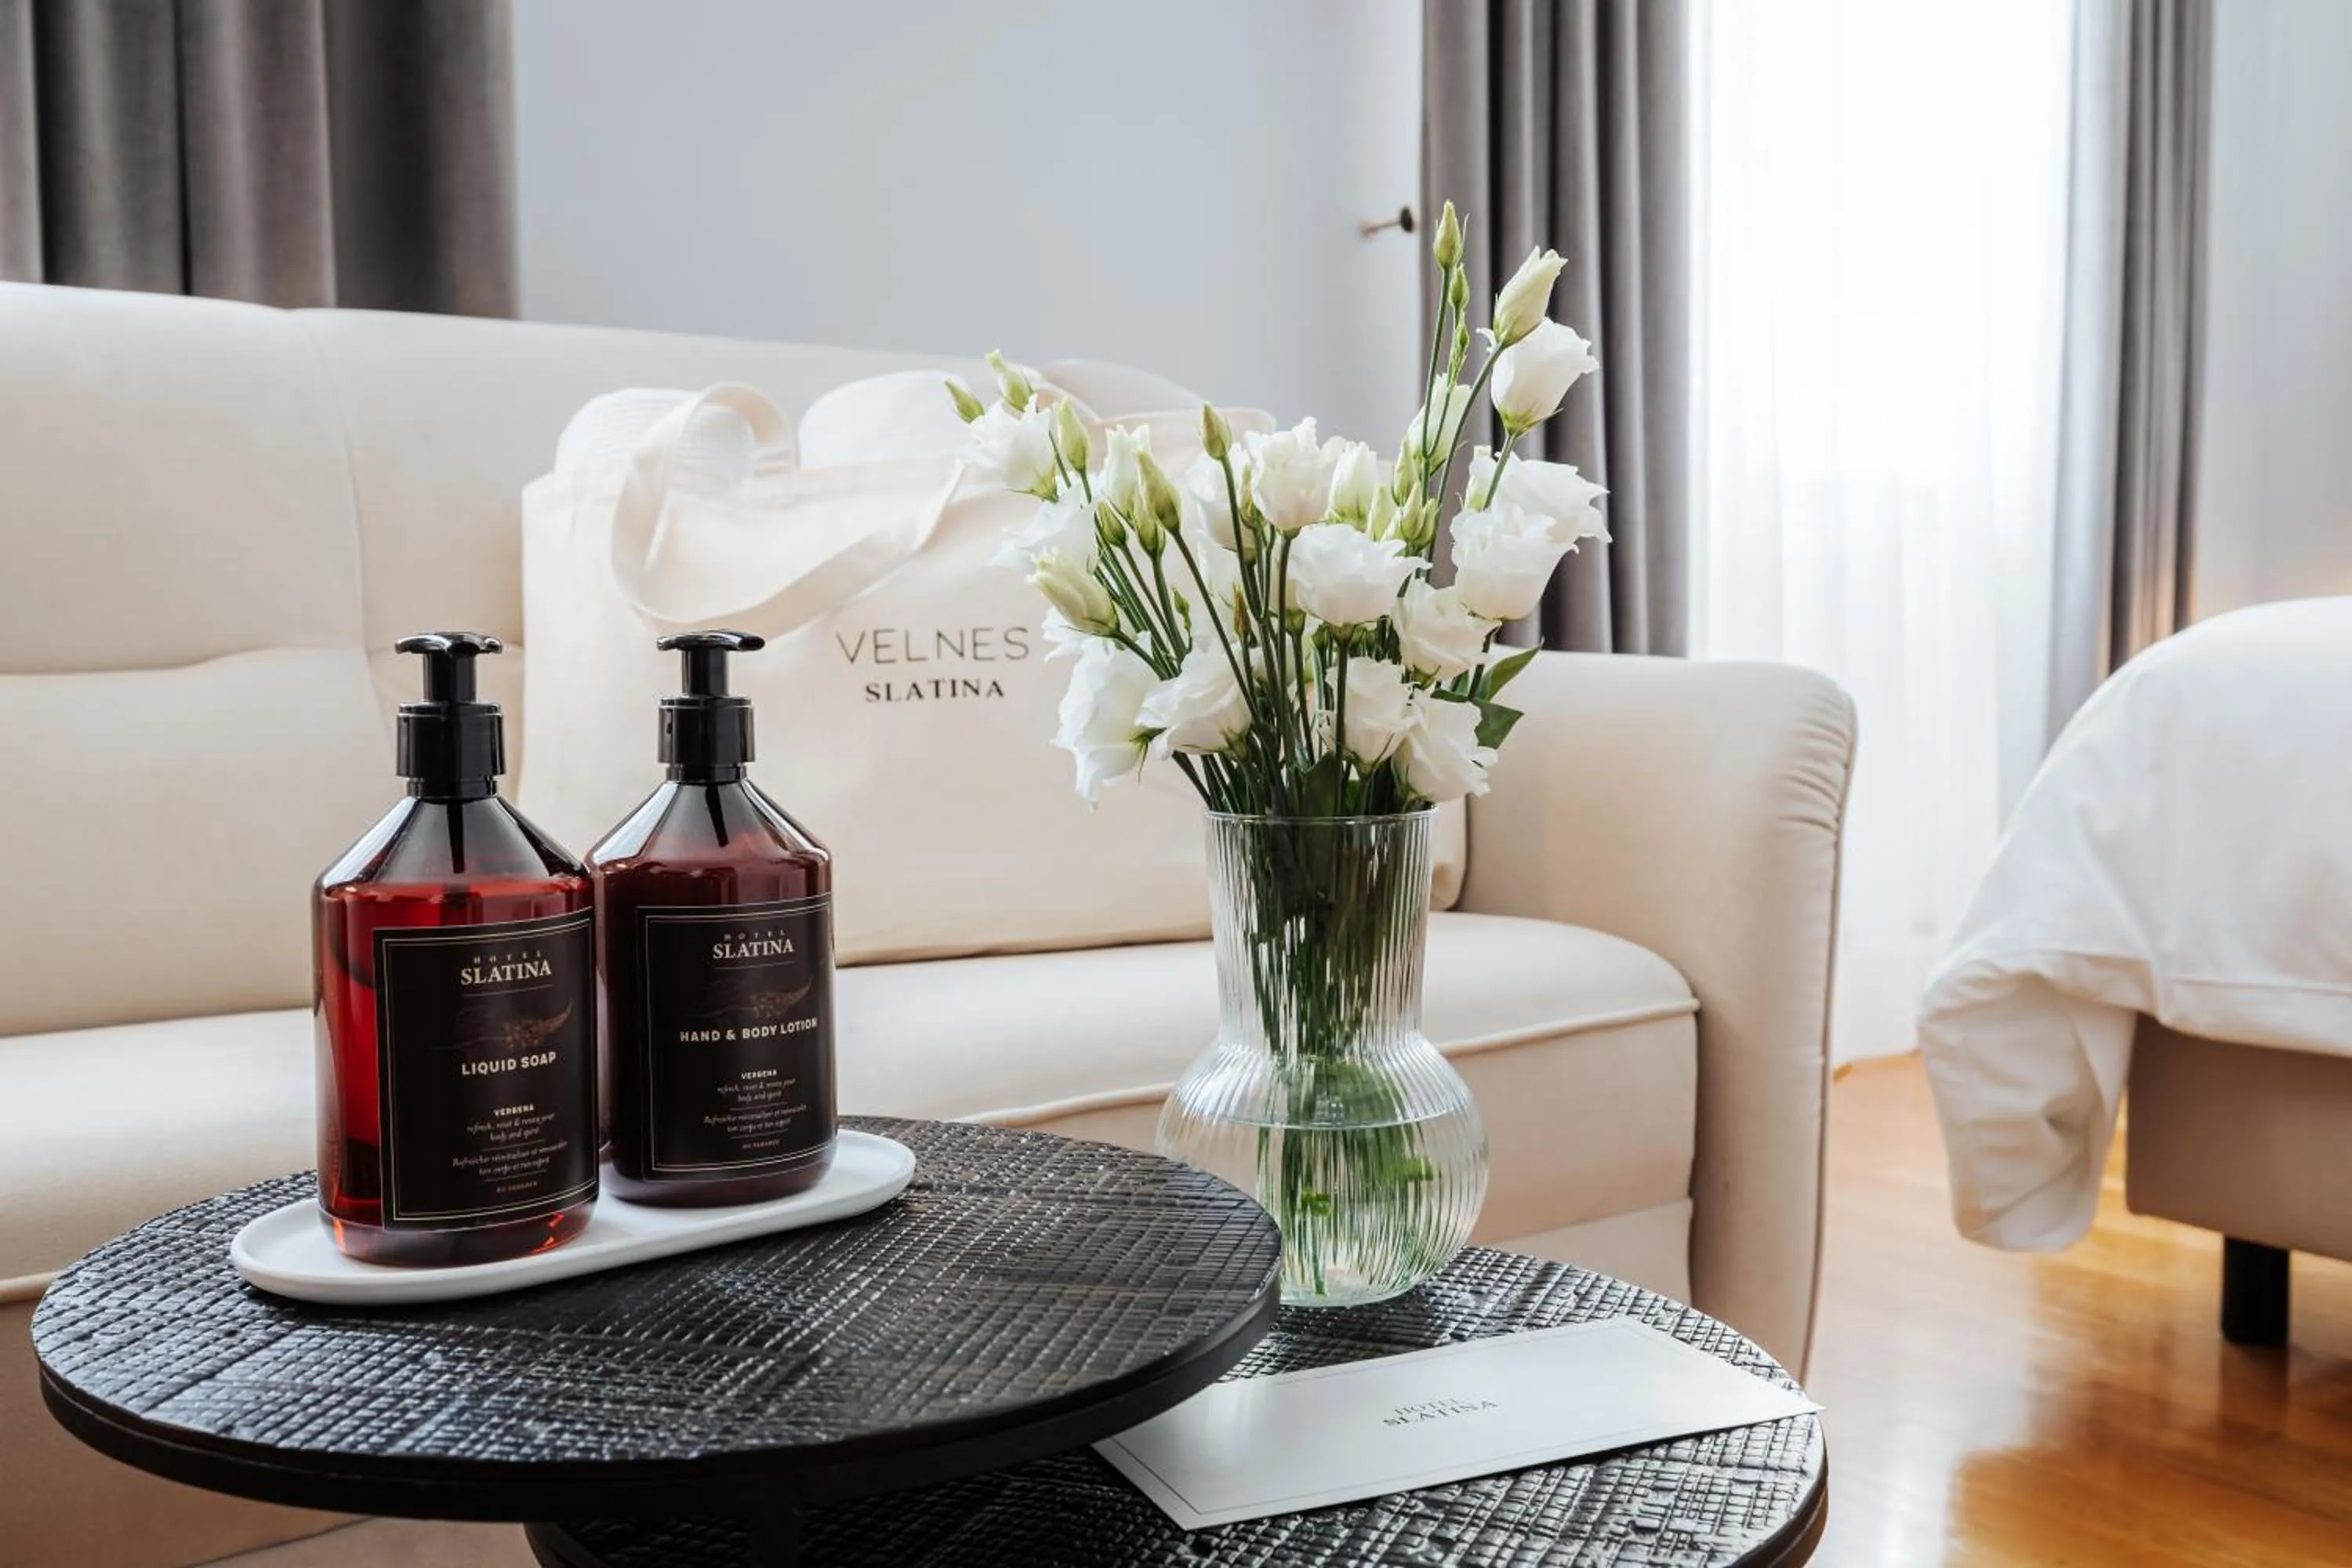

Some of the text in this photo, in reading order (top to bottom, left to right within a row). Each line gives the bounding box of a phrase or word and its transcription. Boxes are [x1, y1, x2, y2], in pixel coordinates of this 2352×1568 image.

[835, 626, 1030, 664] VELNES
[865, 677, 1005, 703] SLATINA
[724, 928, 786, 940] HOTEL
[473, 949, 543, 964] HOTEL
[712, 938, 795, 960] SLATINA
[460, 959, 553, 986] SLATINA
[680, 1017, 818, 1043] HAND & BODY LOTION
[461, 1051, 557, 1076] LIQUID SOAP
[741, 1069, 778, 1080] VERBENA
[493, 1103, 535, 1116] VERBENA
